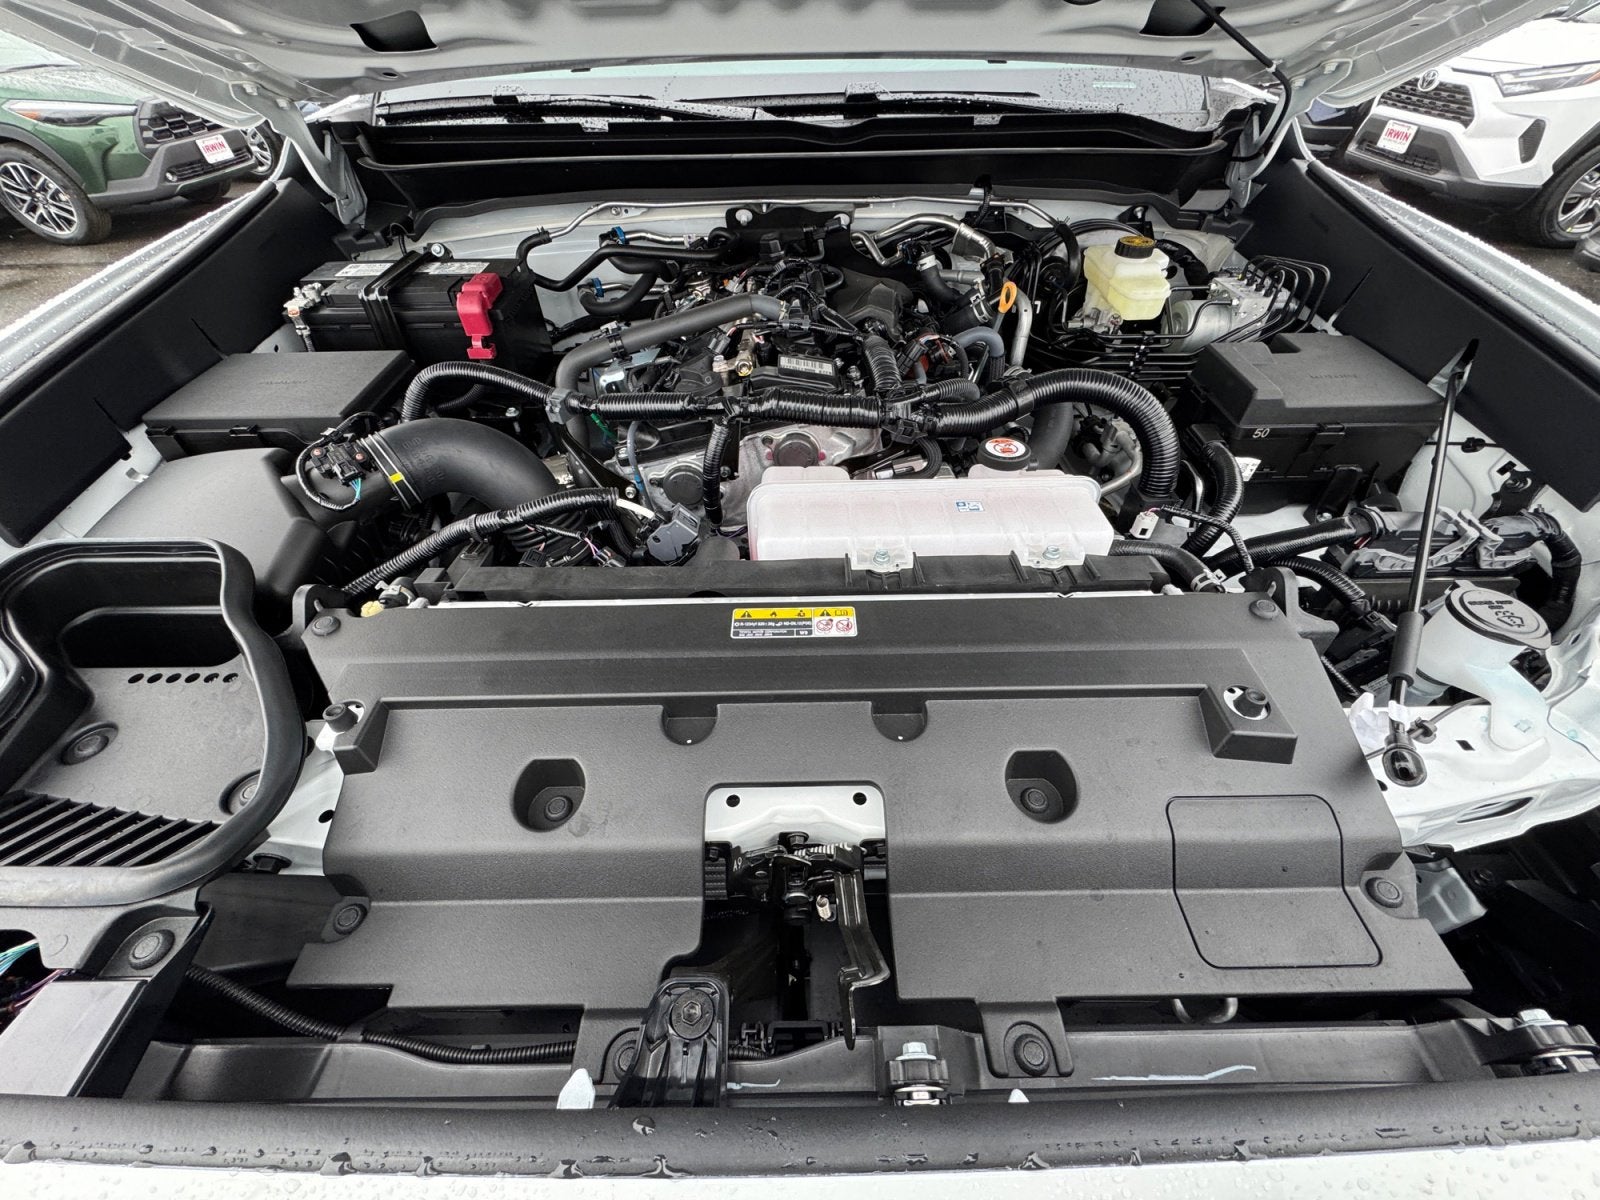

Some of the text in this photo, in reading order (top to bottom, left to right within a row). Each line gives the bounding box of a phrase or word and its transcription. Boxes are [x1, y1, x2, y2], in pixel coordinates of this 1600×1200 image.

[1384, 127, 1412, 142] IRWIN
[202, 140, 226, 154] IRWIN
[1252, 428, 1271, 438] 50
